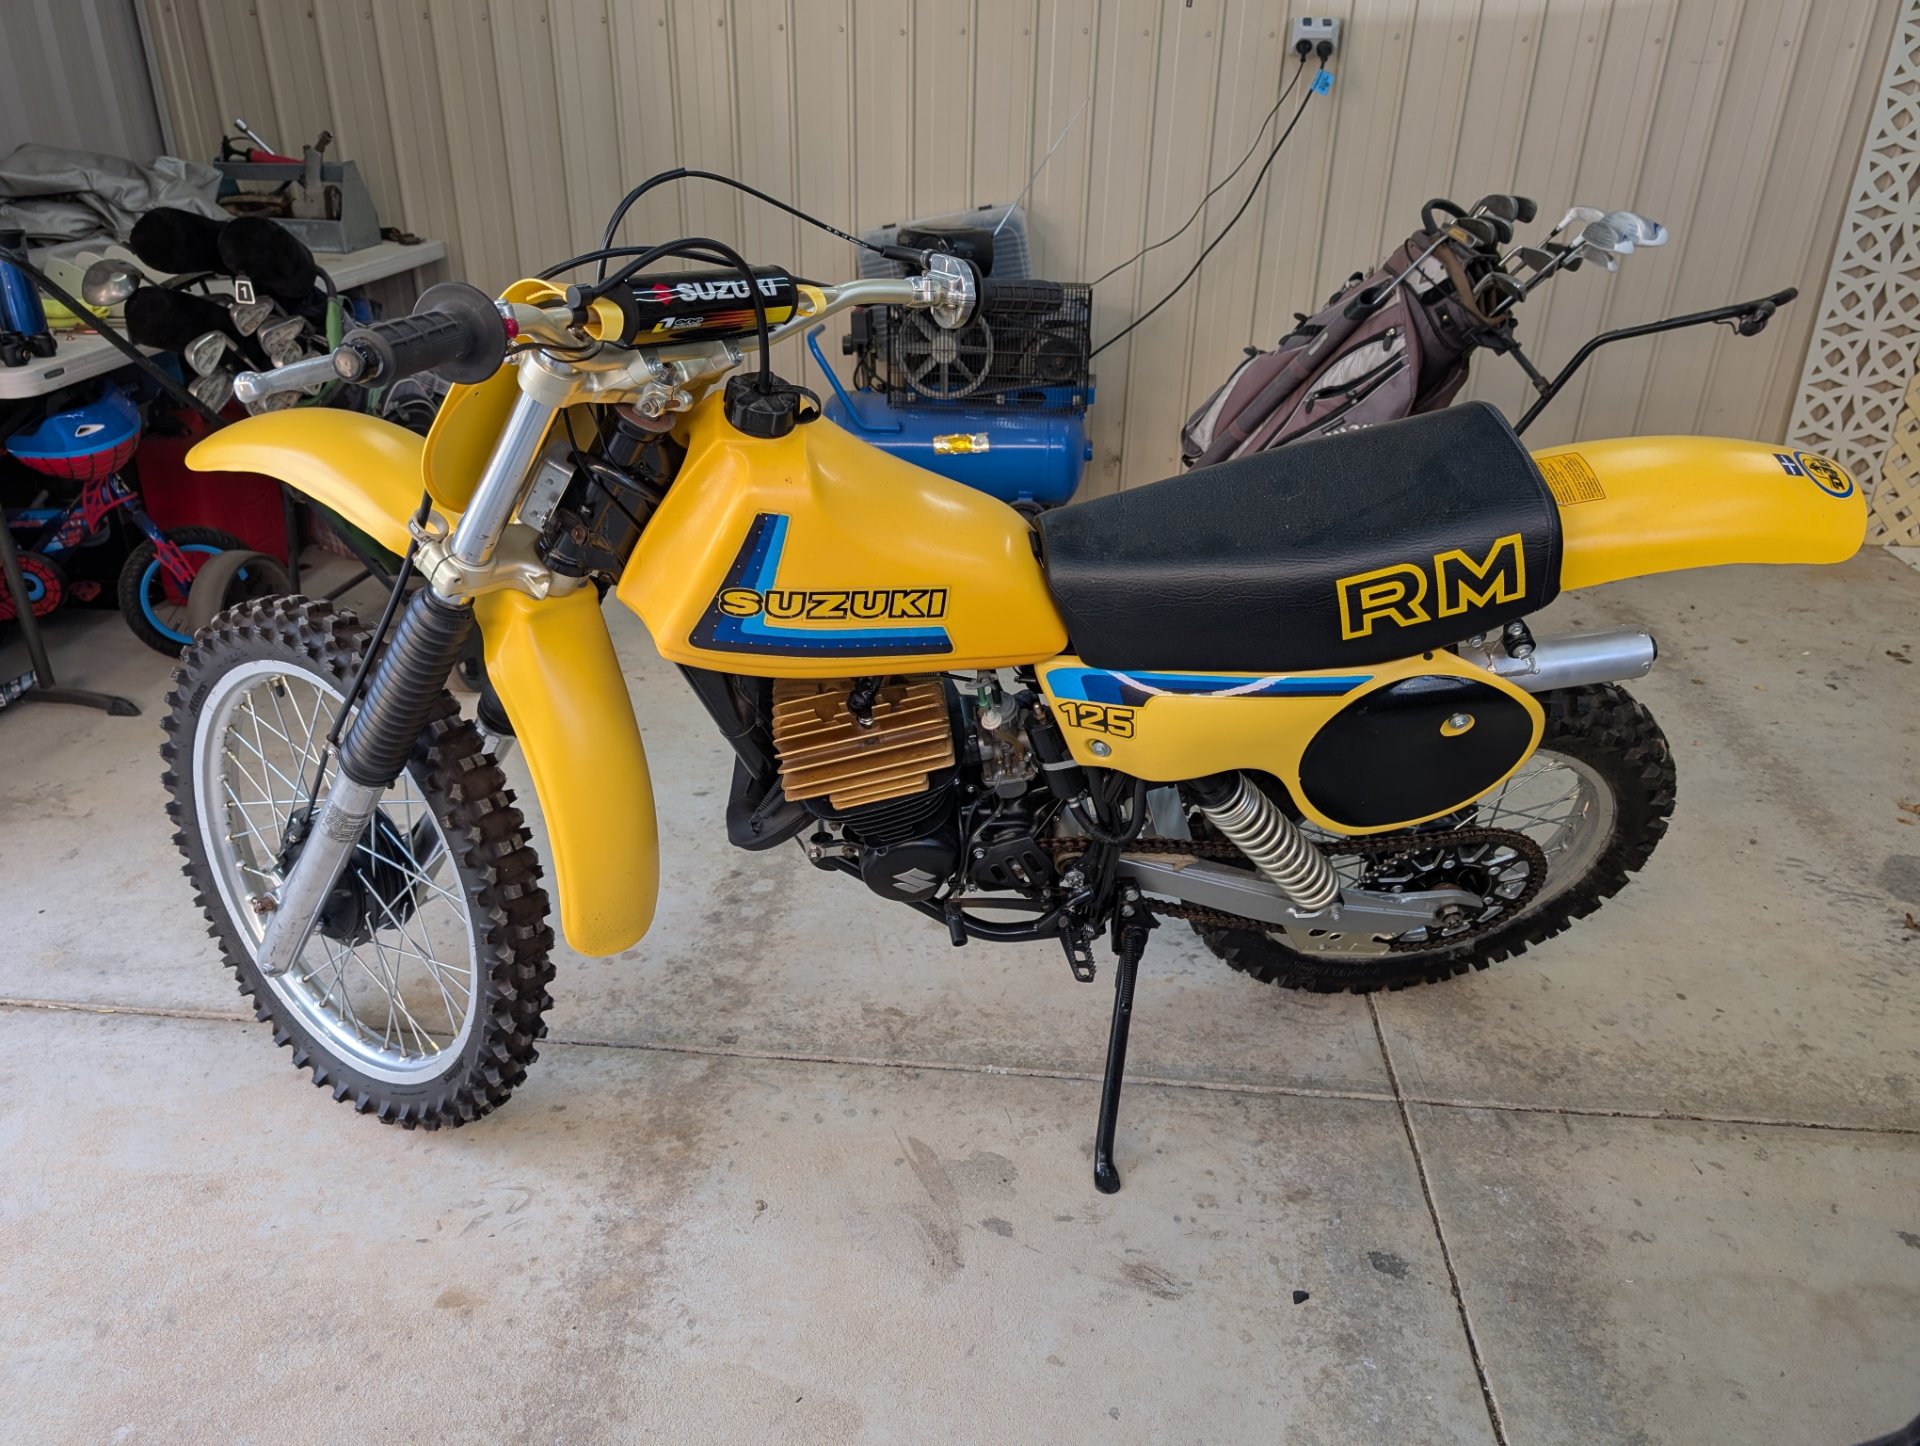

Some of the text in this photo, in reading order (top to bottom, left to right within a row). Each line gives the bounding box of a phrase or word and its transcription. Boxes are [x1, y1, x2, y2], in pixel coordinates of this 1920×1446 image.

[239, 286, 248, 299] 1
[719, 588, 947, 618] SUZUKI
[1336, 533, 1526, 640] RM
[1059, 702, 1134, 739] 125
